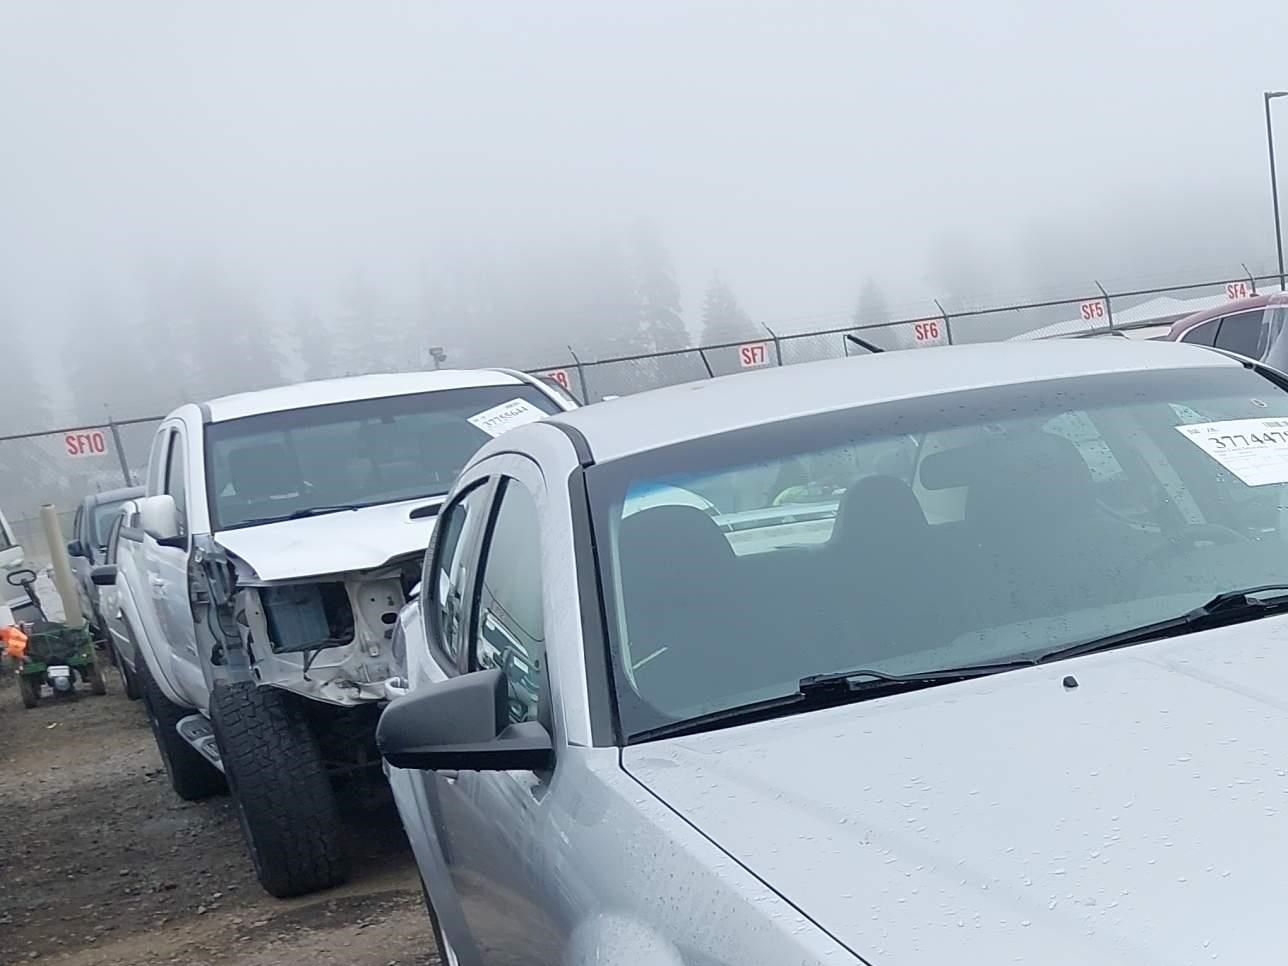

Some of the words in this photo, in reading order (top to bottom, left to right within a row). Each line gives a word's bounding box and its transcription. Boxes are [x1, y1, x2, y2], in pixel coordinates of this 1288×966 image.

[1227, 284, 1247, 300] SF4
[1082, 302, 1104, 321] SF5
[915, 322, 938, 341] SF6
[742, 346, 766, 365] SF7
[65, 432, 105, 455] SF10
